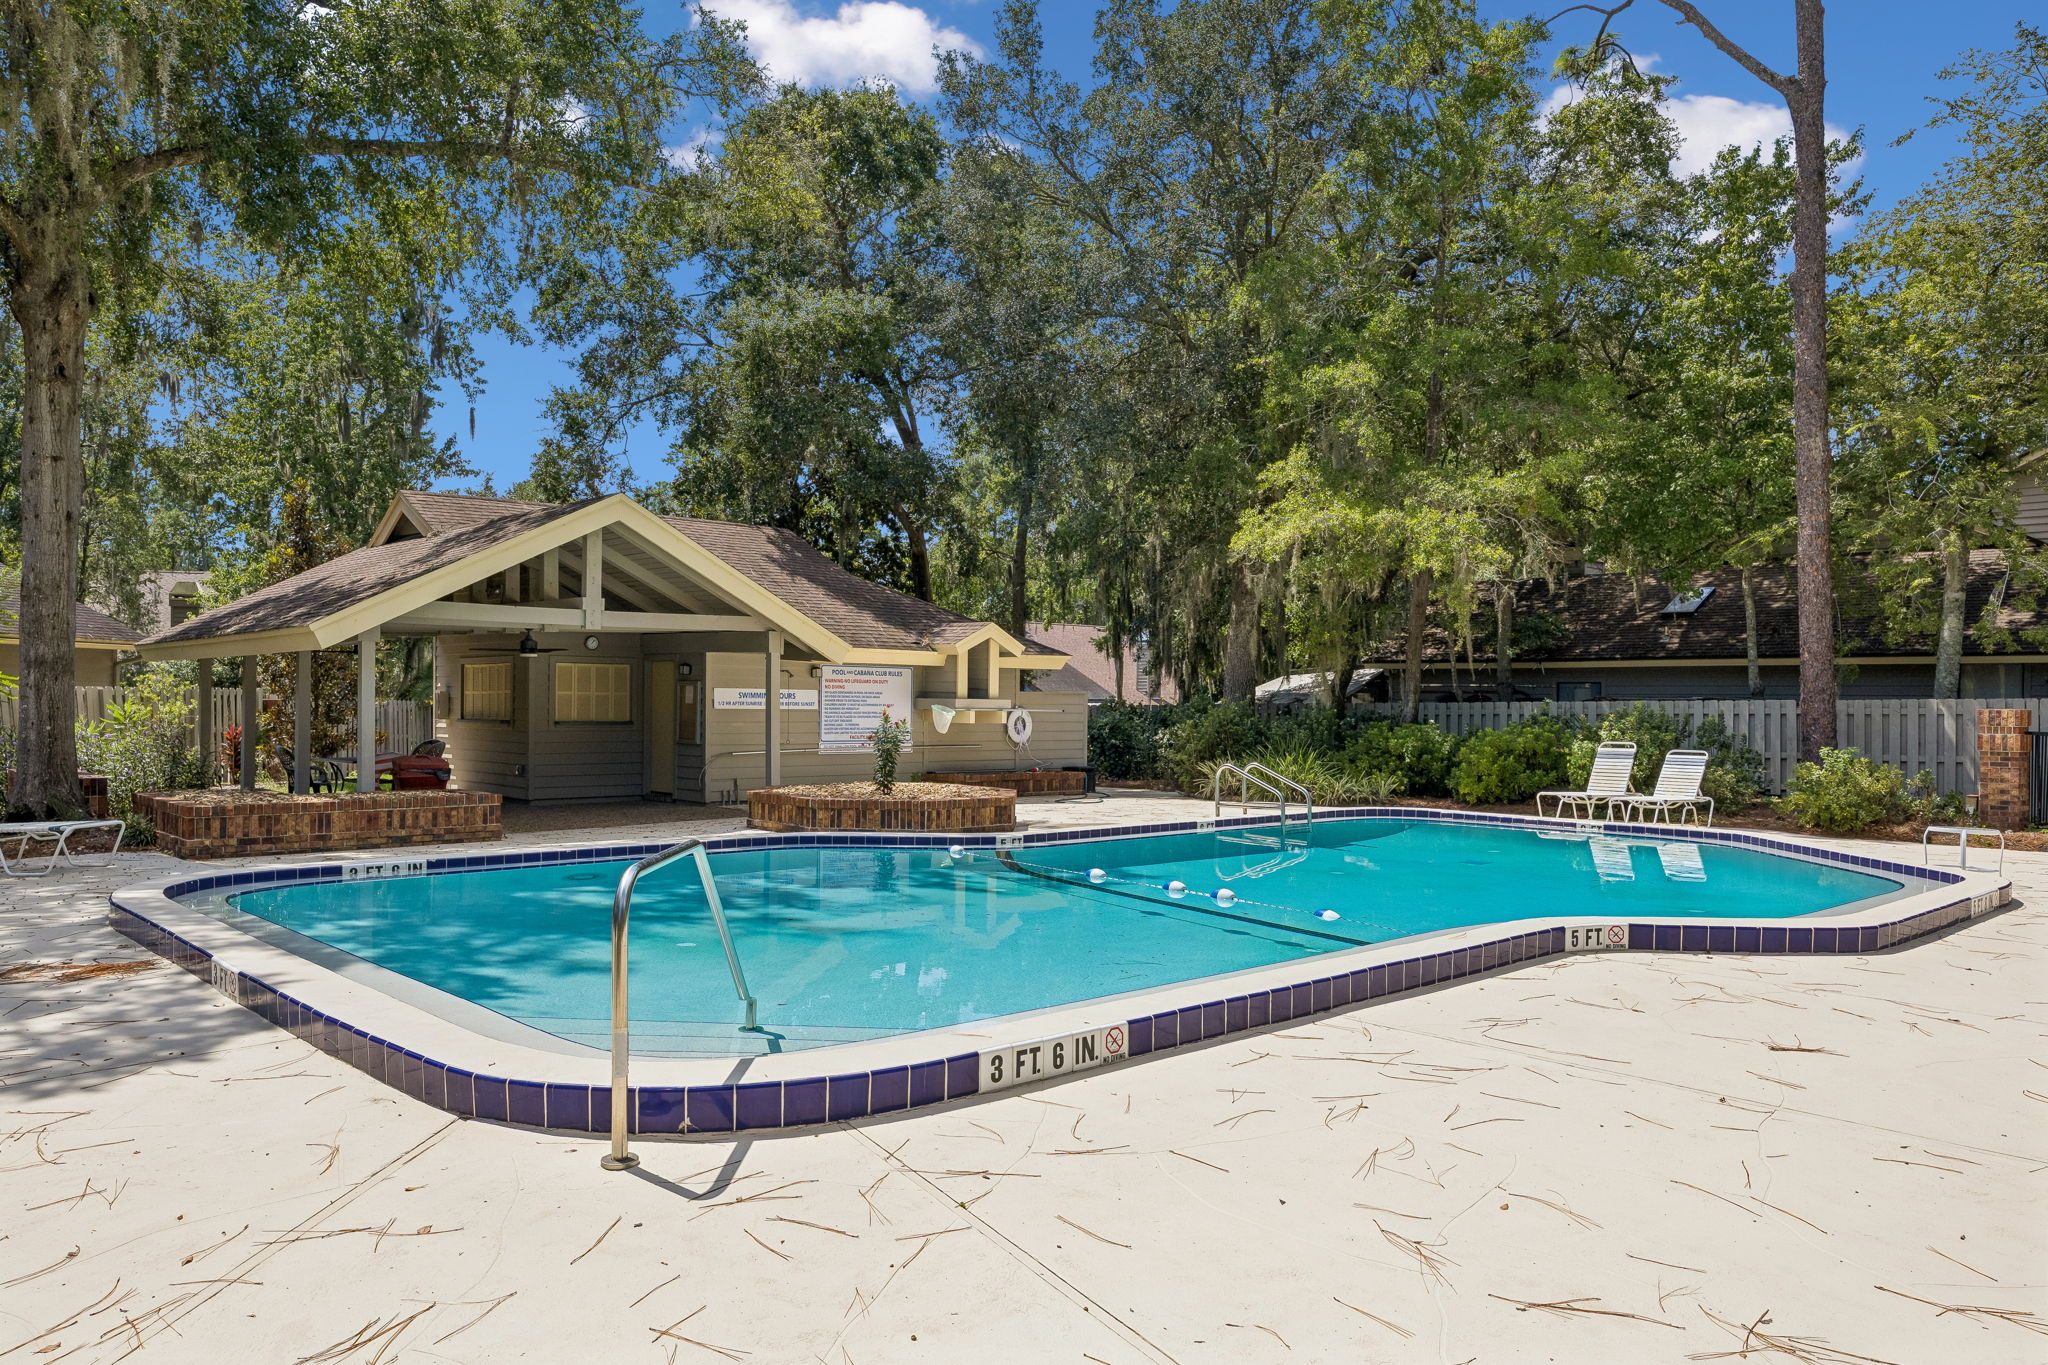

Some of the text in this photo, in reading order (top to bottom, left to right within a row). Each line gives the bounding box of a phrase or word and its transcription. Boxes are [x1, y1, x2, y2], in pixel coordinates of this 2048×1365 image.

[1571, 928, 1603, 948] 5 FT.
[990, 1034, 1099, 1084] 3 FT. 6 IN.
[1103, 1052, 1126, 1064] NO DIVING
